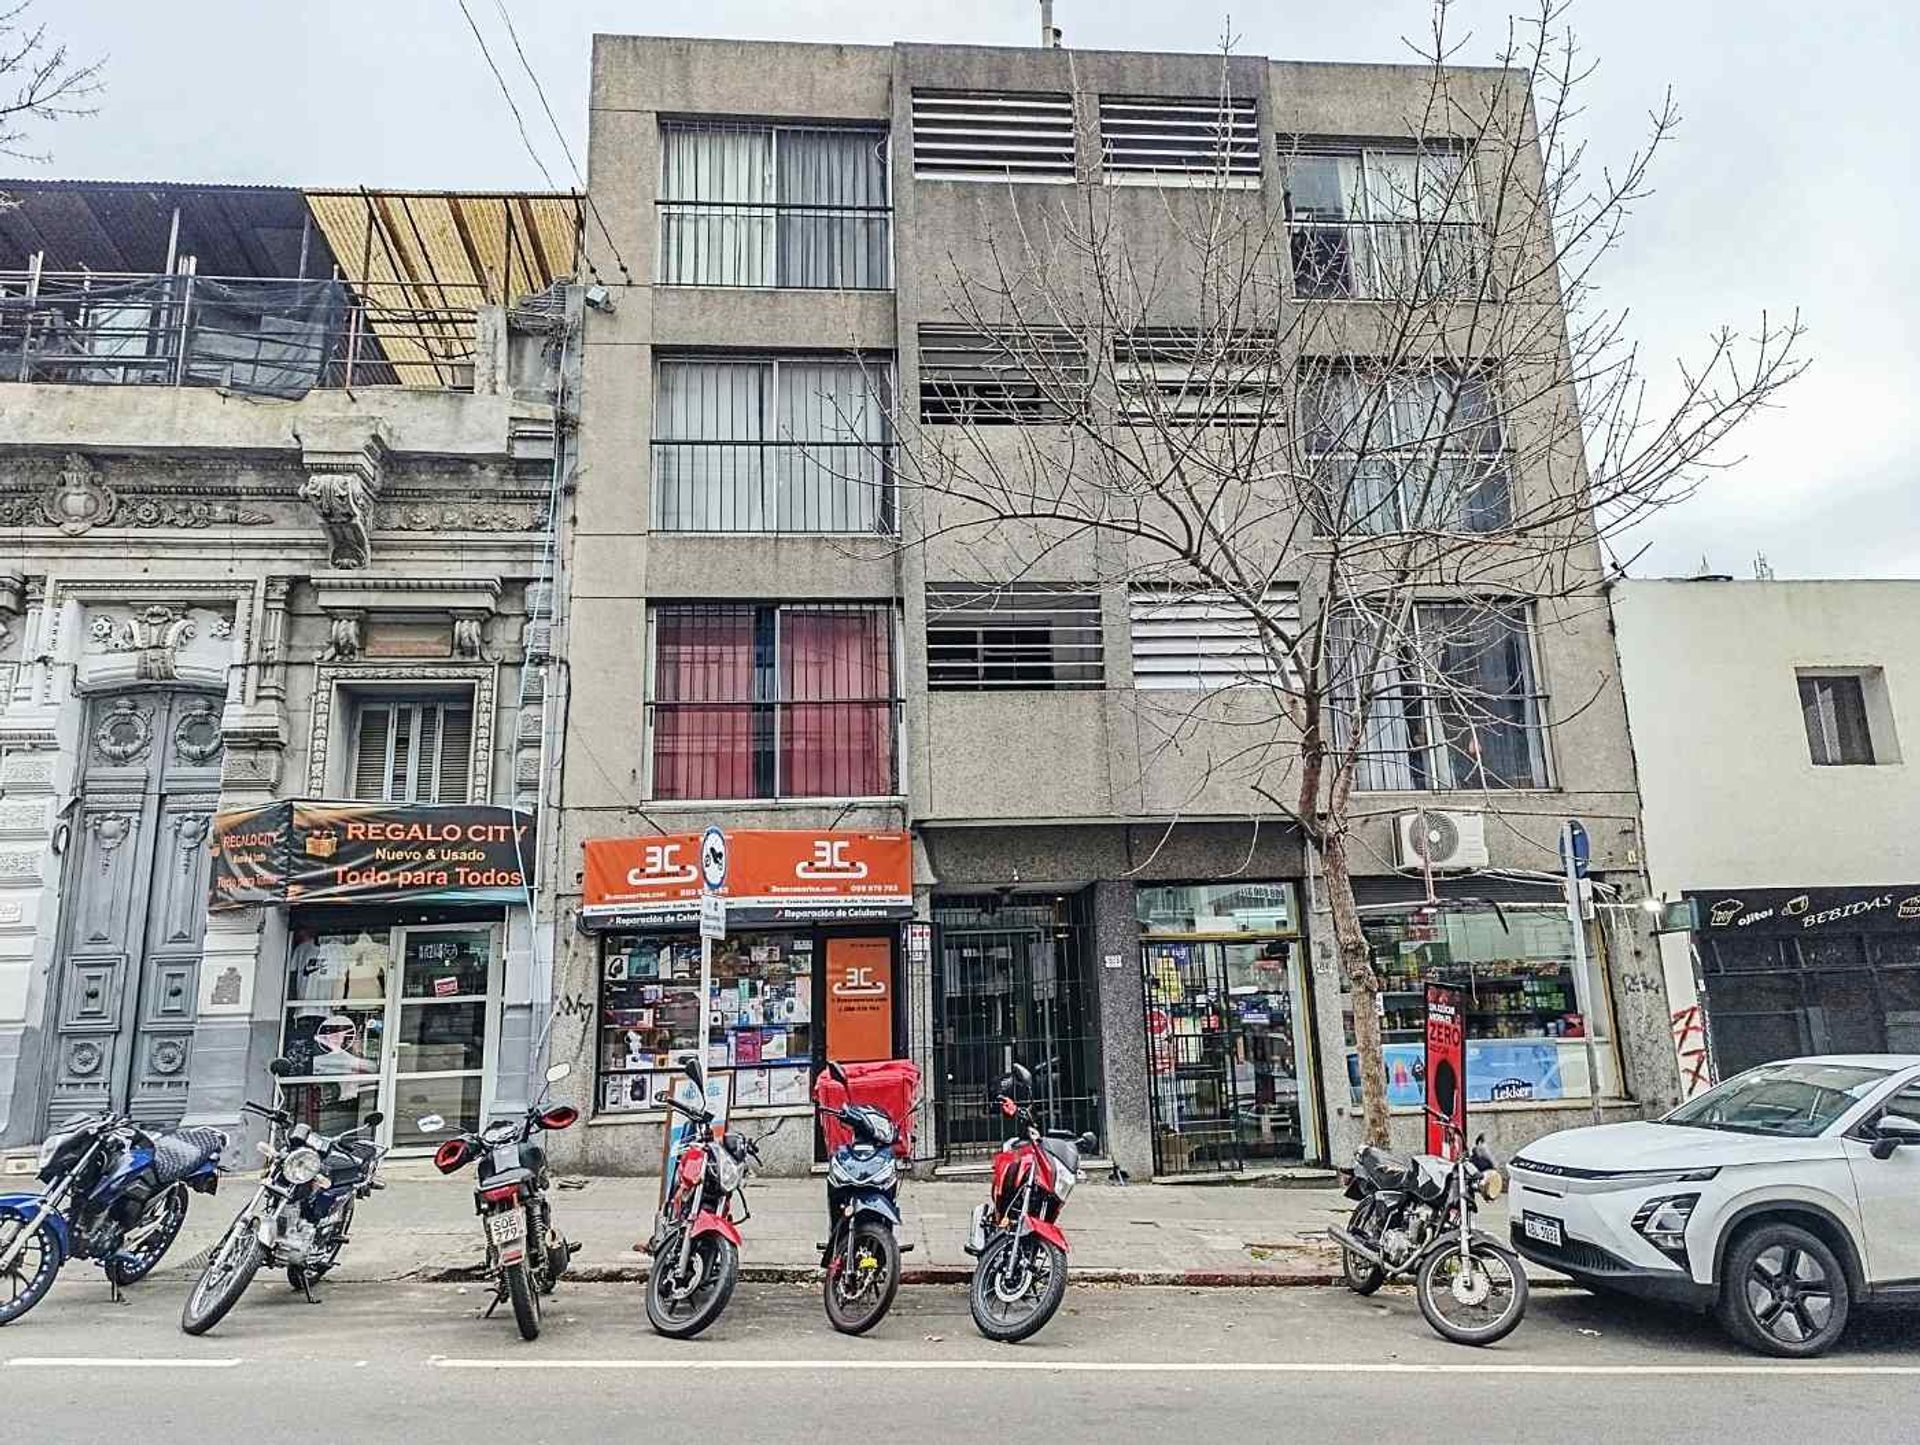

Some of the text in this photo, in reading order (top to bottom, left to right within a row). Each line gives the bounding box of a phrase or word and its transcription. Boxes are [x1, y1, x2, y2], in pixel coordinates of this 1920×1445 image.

[347, 823, 527, 843] REGALO CITY
[375, 848, 486, 861] Nuevo & Usado
[645, 844, 681, 873] 3C
[813, 840, 850, 868] 3C
[335, 866, 523, 888] Todo para Todos
[615, 914, 663, 926] Reparación
[664, 913, 675, 923] de
[785, 908, 888, 921] Reparación de Celulares
[1802, 894, 1893, 927] BEBIDAS
[845, 967, 873, 987] 3C
[1429, 1021, 1461, 1047] ZERO
[1493, 1086, 1530, 1100] Lekker
